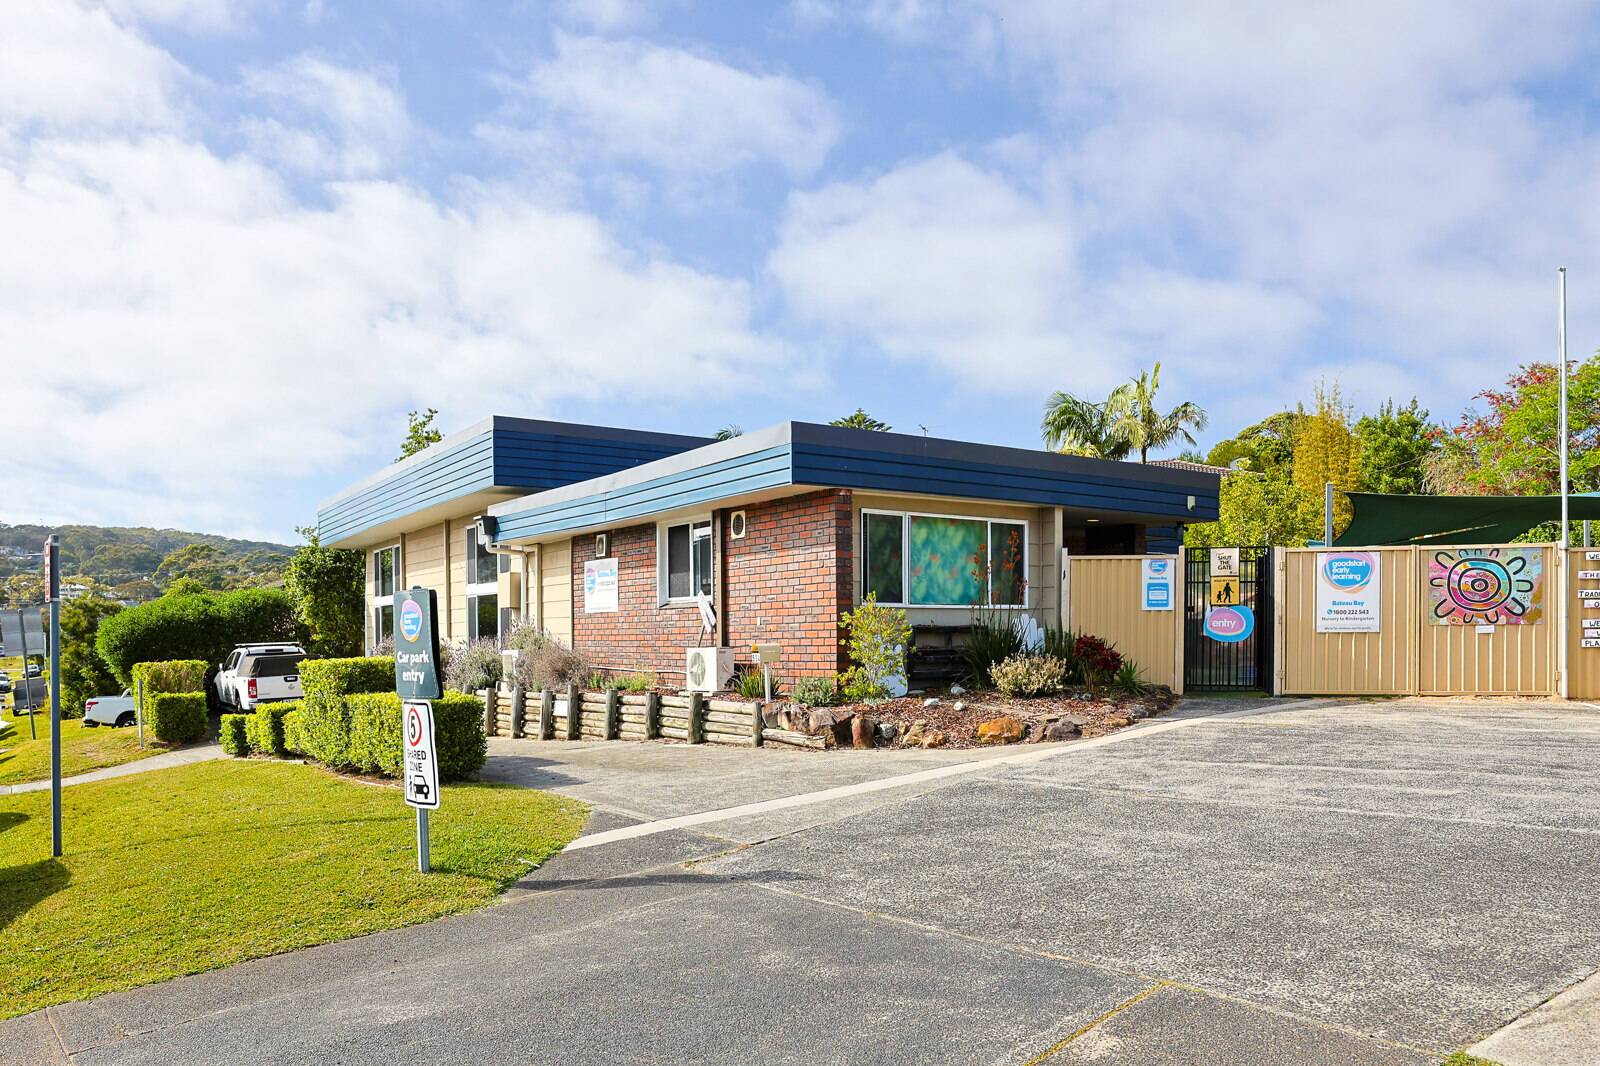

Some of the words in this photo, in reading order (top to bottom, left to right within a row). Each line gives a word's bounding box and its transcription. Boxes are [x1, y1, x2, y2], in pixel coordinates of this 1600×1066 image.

[1332, 560, 1366, 568] goodstart
[1332, 567, 1350, 575] early
[1212, 618, 1235, 628] entry
[397, 651, 409, 663] Car
[410, 649, 429, 666] park
[402, 669, 425, 685] entry
[410, 715, 416, 740] 5
